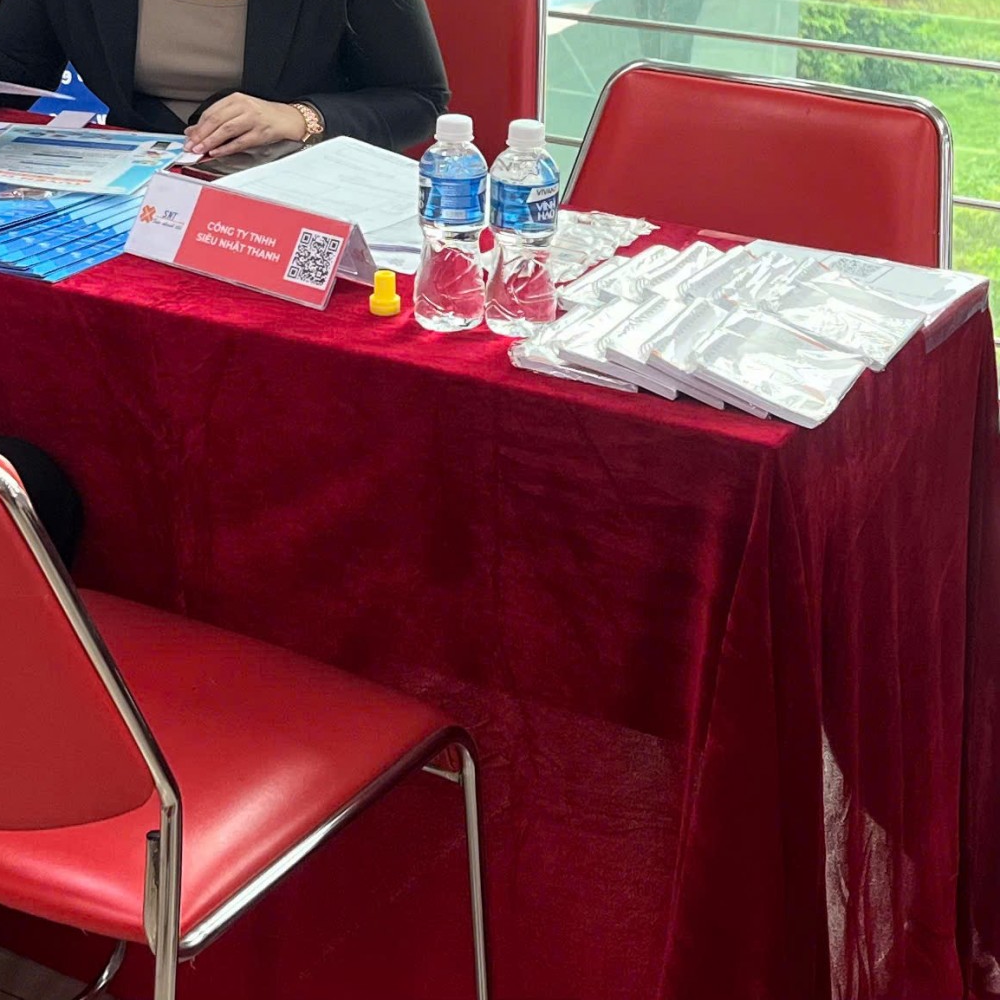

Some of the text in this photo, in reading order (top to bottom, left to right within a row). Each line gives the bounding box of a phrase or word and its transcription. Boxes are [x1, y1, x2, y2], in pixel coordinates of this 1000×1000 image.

[195, 232, 218, 246] SIÊU
[246, 245, 281, 263] THANH
[207, 221, 277, 247] CÔNG TY TNHH
